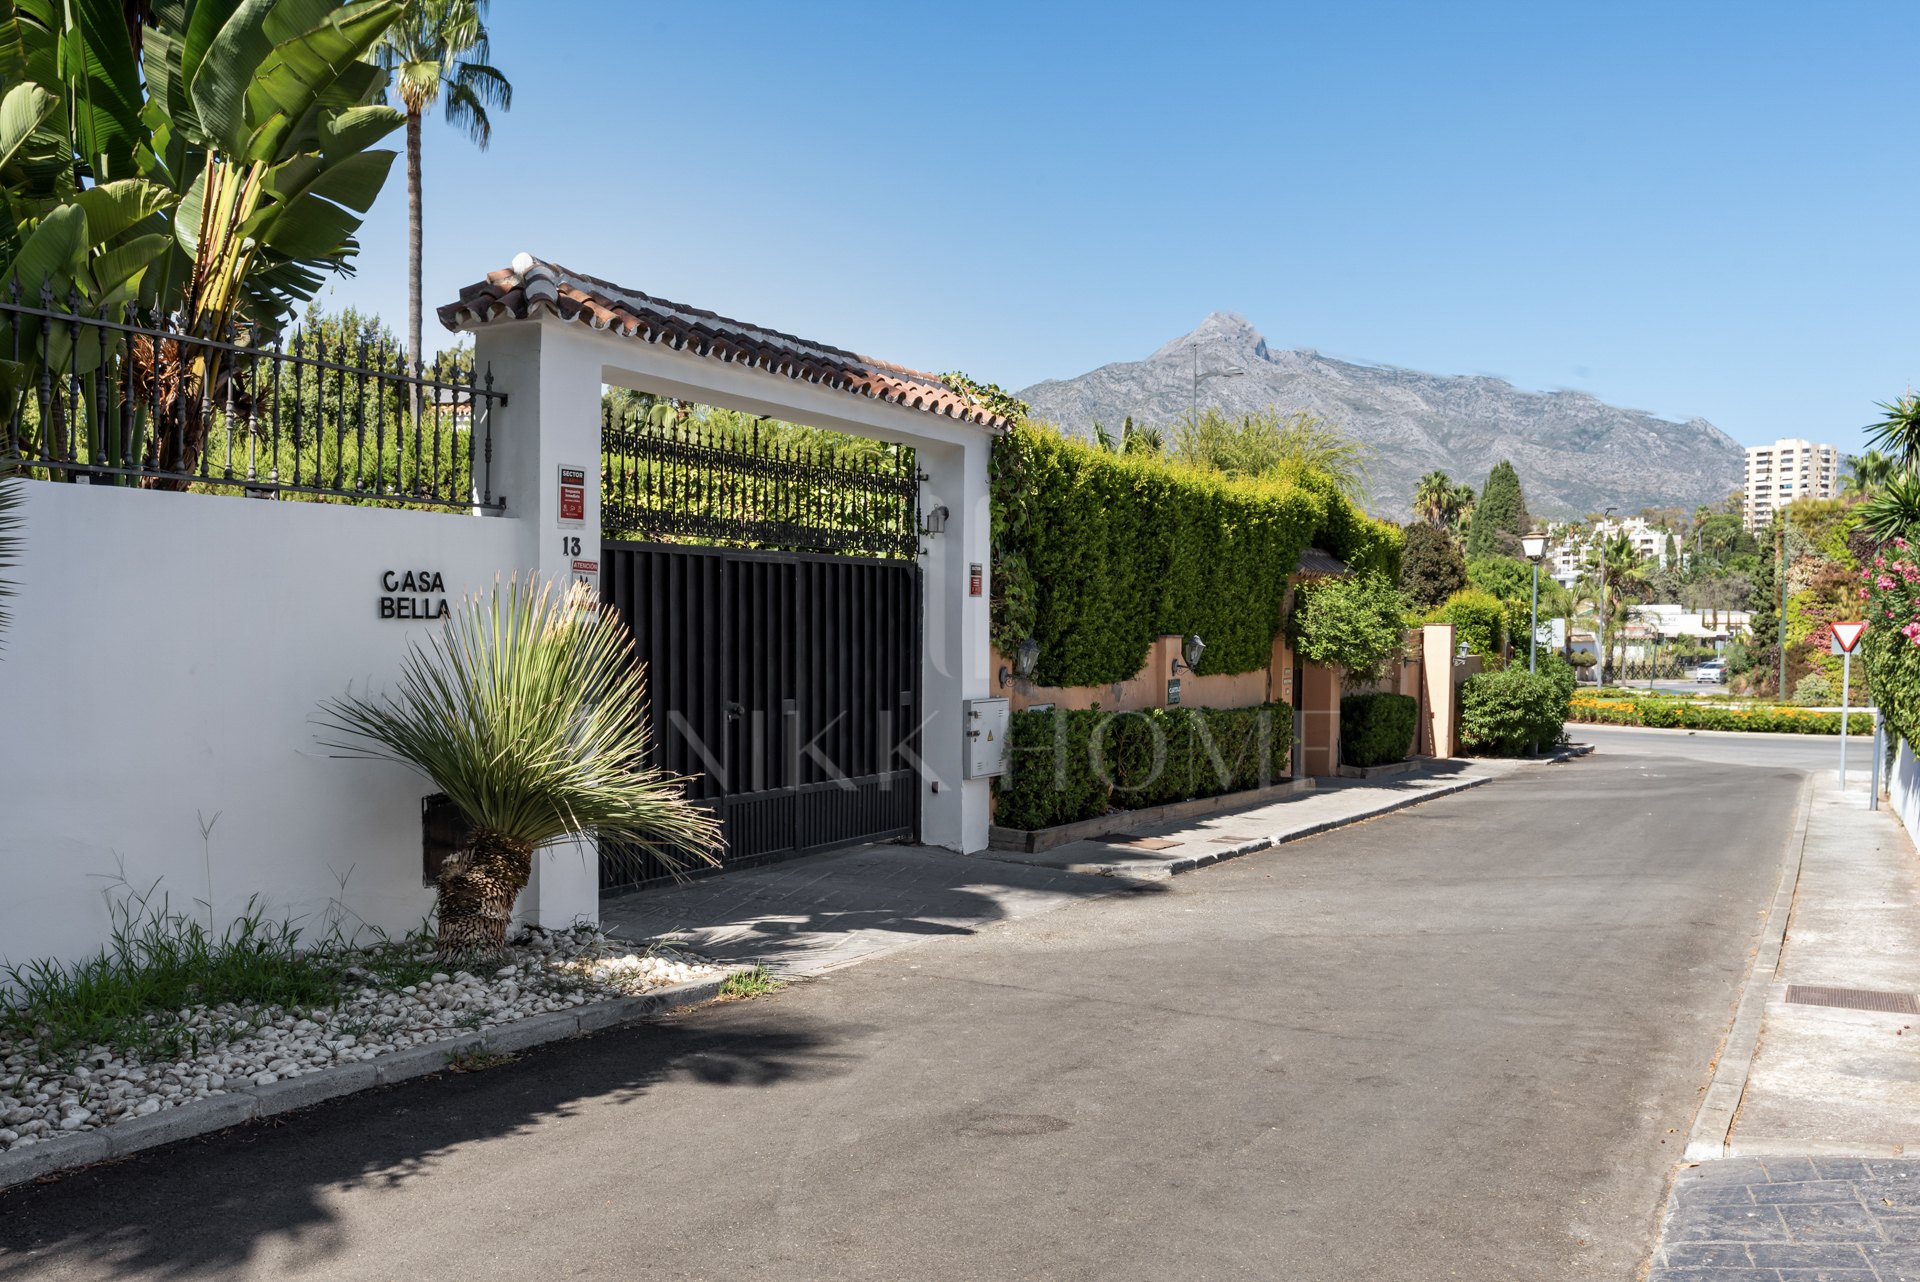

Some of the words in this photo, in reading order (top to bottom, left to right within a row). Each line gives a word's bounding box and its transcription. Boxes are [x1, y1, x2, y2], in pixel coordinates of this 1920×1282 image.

[562, 470, 583, 478] SECTOR
[563, 536, 581, 556] 13
[383, 570, 446, 593] CASA
[380, 596, 452, 620] BELLA
